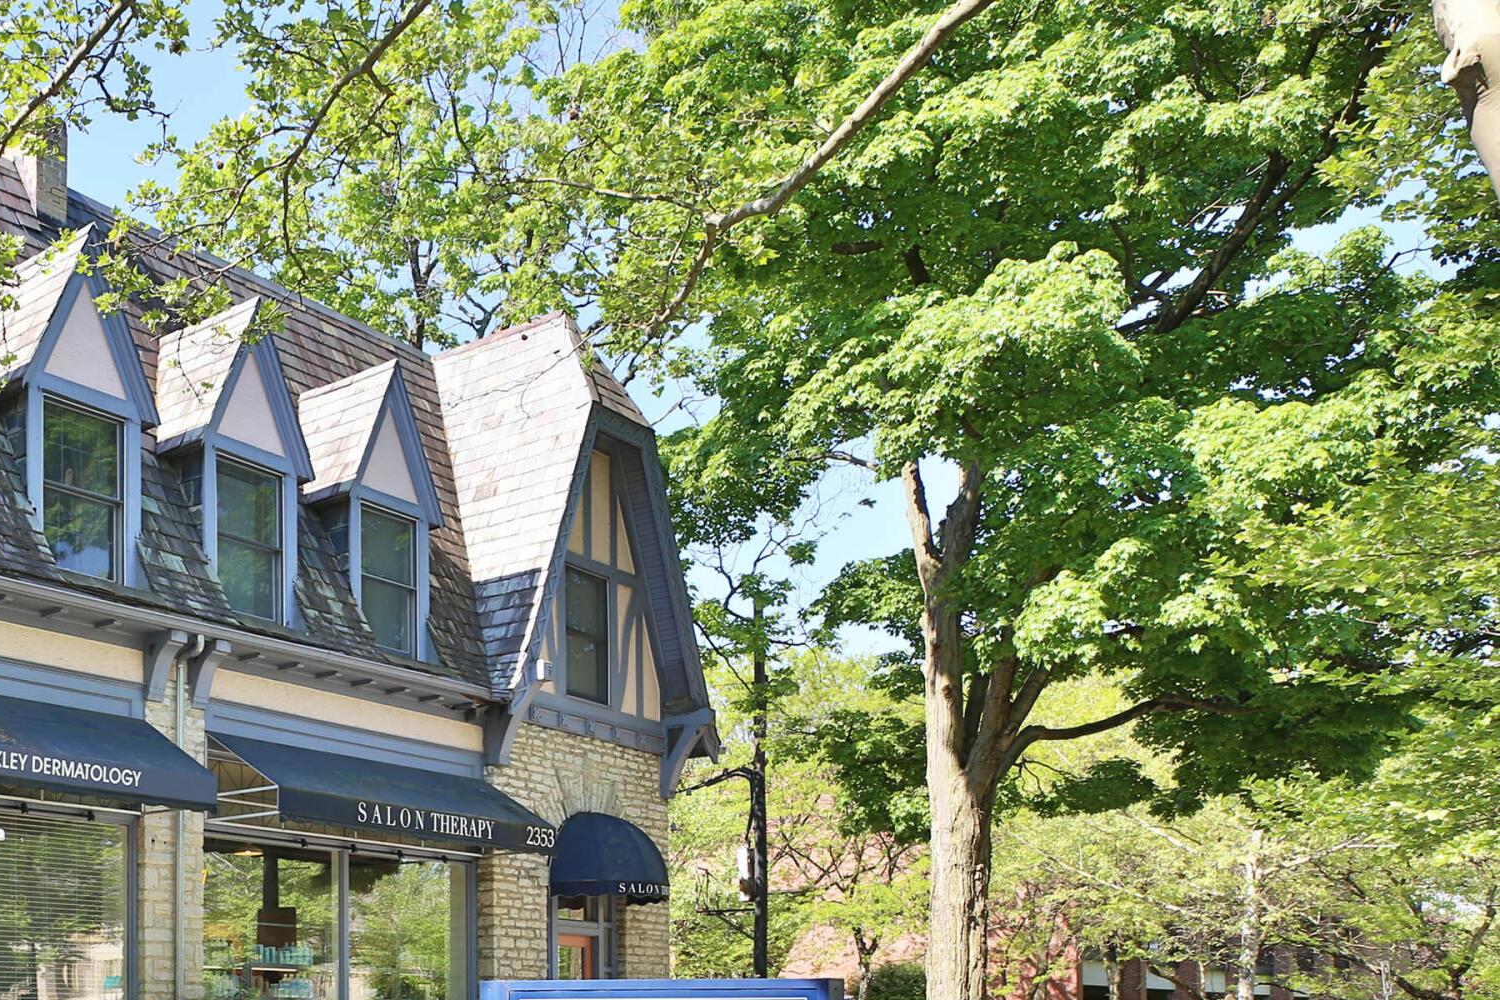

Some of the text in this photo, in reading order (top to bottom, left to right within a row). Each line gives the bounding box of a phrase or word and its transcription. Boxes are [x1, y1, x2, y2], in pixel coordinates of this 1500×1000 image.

[31, 755, 142, 787] DERMATOLOGY
[357, 801, 496, 841] SALON THERAPY
[525, 825, 556, 848] 2353
[618, 882, 660, 895] SALON
